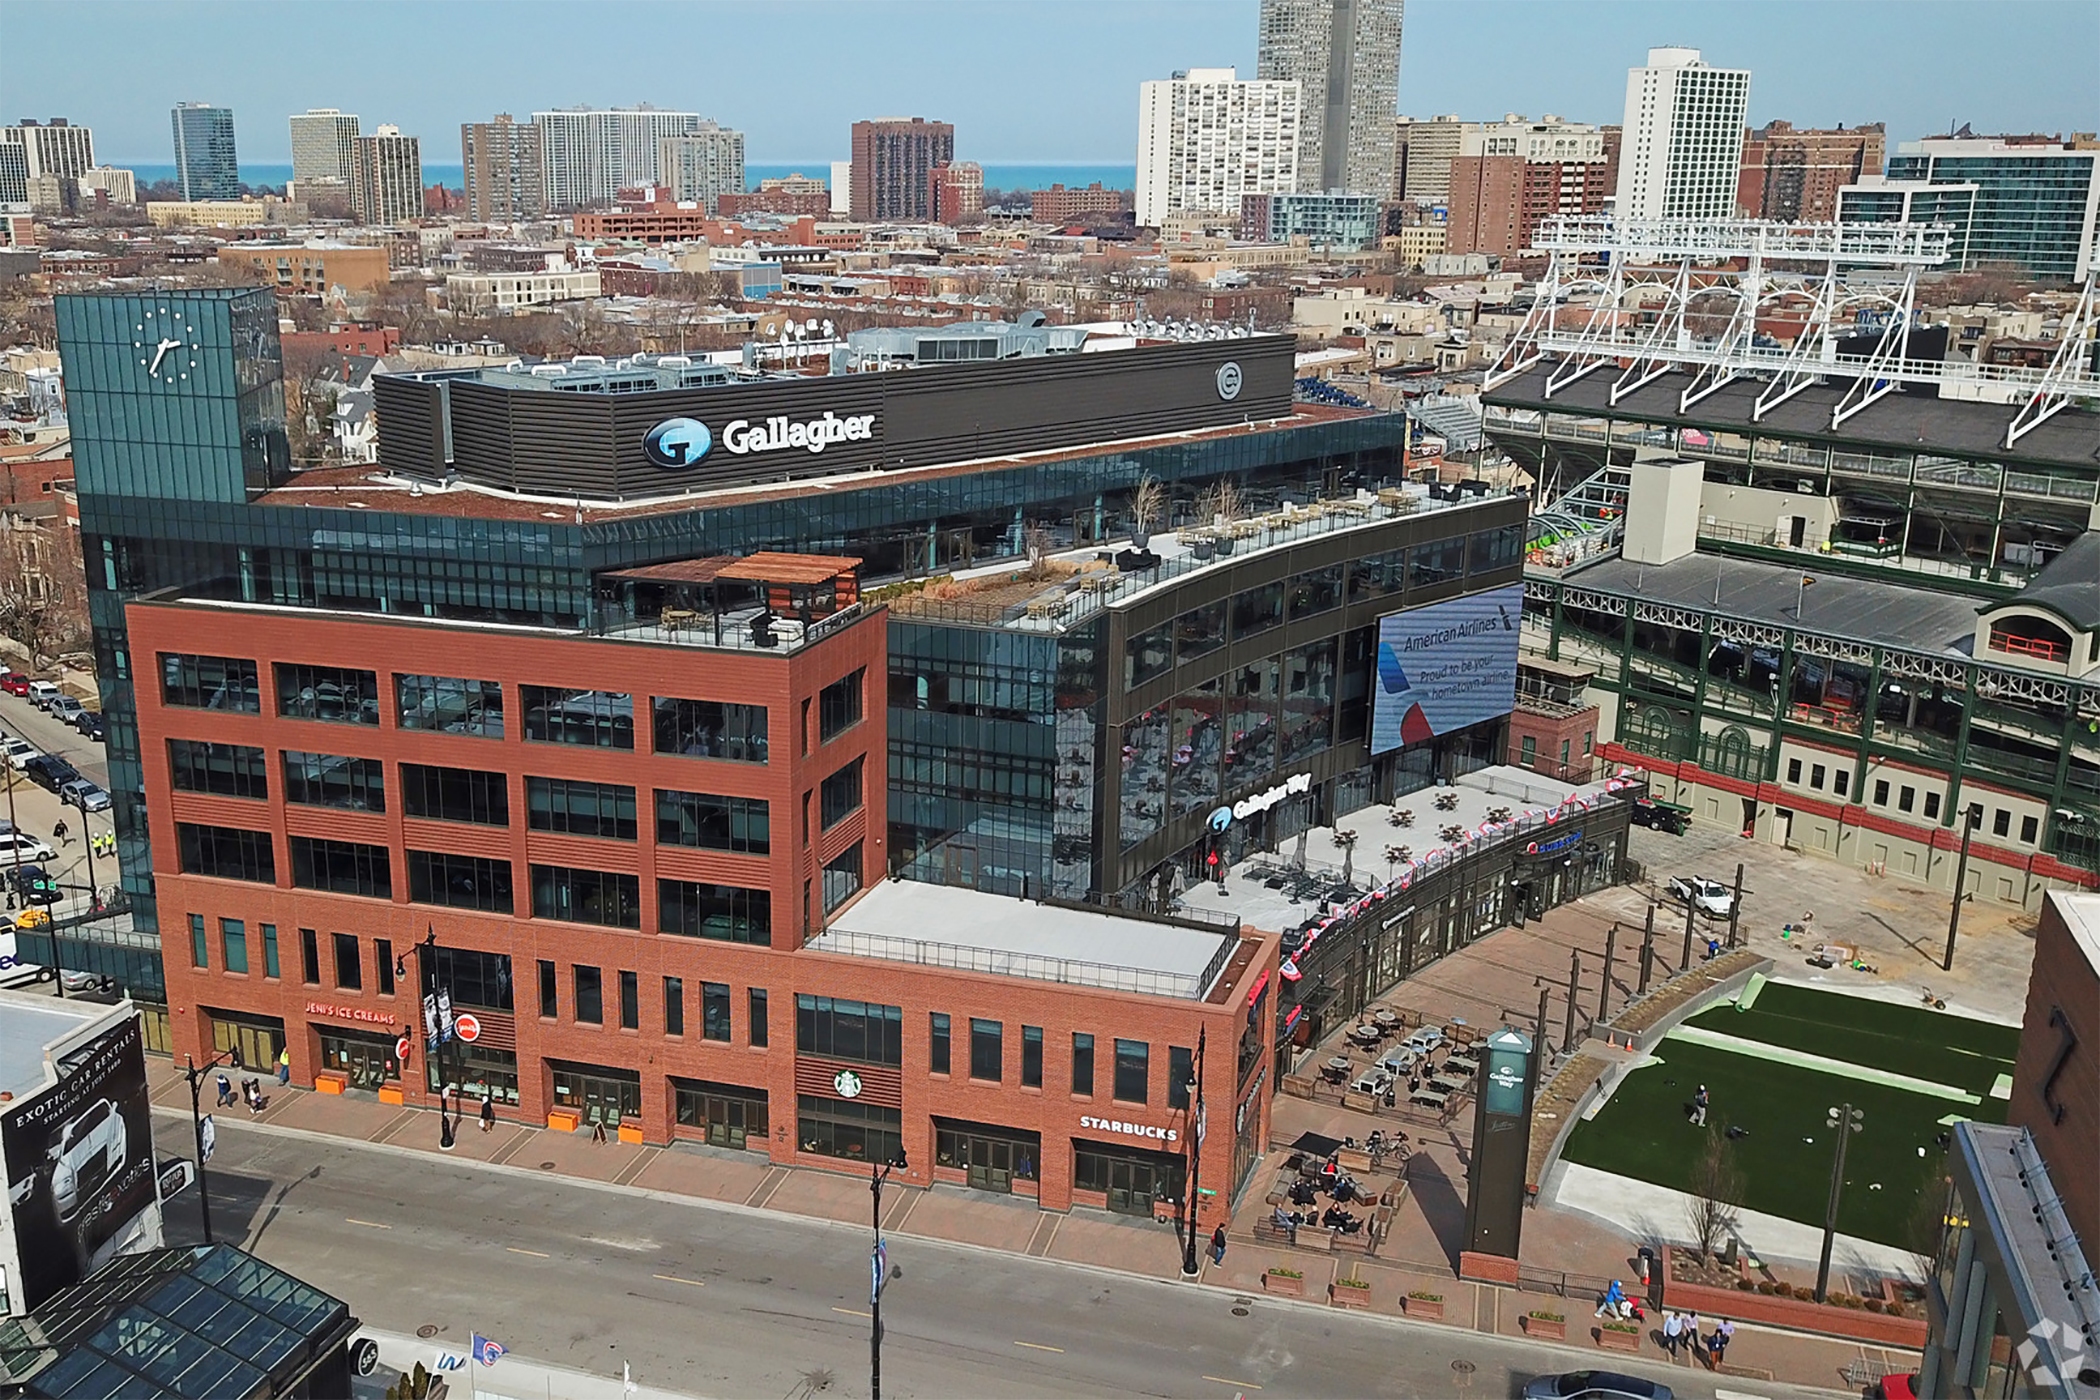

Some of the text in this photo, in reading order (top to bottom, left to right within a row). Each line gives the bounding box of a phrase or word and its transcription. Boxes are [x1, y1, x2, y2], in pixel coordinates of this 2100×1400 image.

[722, 411, 875, 454] Gallagher
[1404, 616, 1497, 653] American Airlines
[1420, 654, 1494, 683] Proud to be your
[1432, 678, 1481, 700] hometown
[306, 1001, 395, 1025] JENI'S ICE CREAMS
[16, 1029, 135, 1128] EXOTIC CAR RENTALS
[1489, 1072, 1524, 1083] Gallagher
[43, 1094, 81, 1125] STARTING
[82, 1086, 90, 1096] AT
[91, 1071, 106, 1088] JUST
[1080, 1115, 1177, 1141] STARBUCKS
